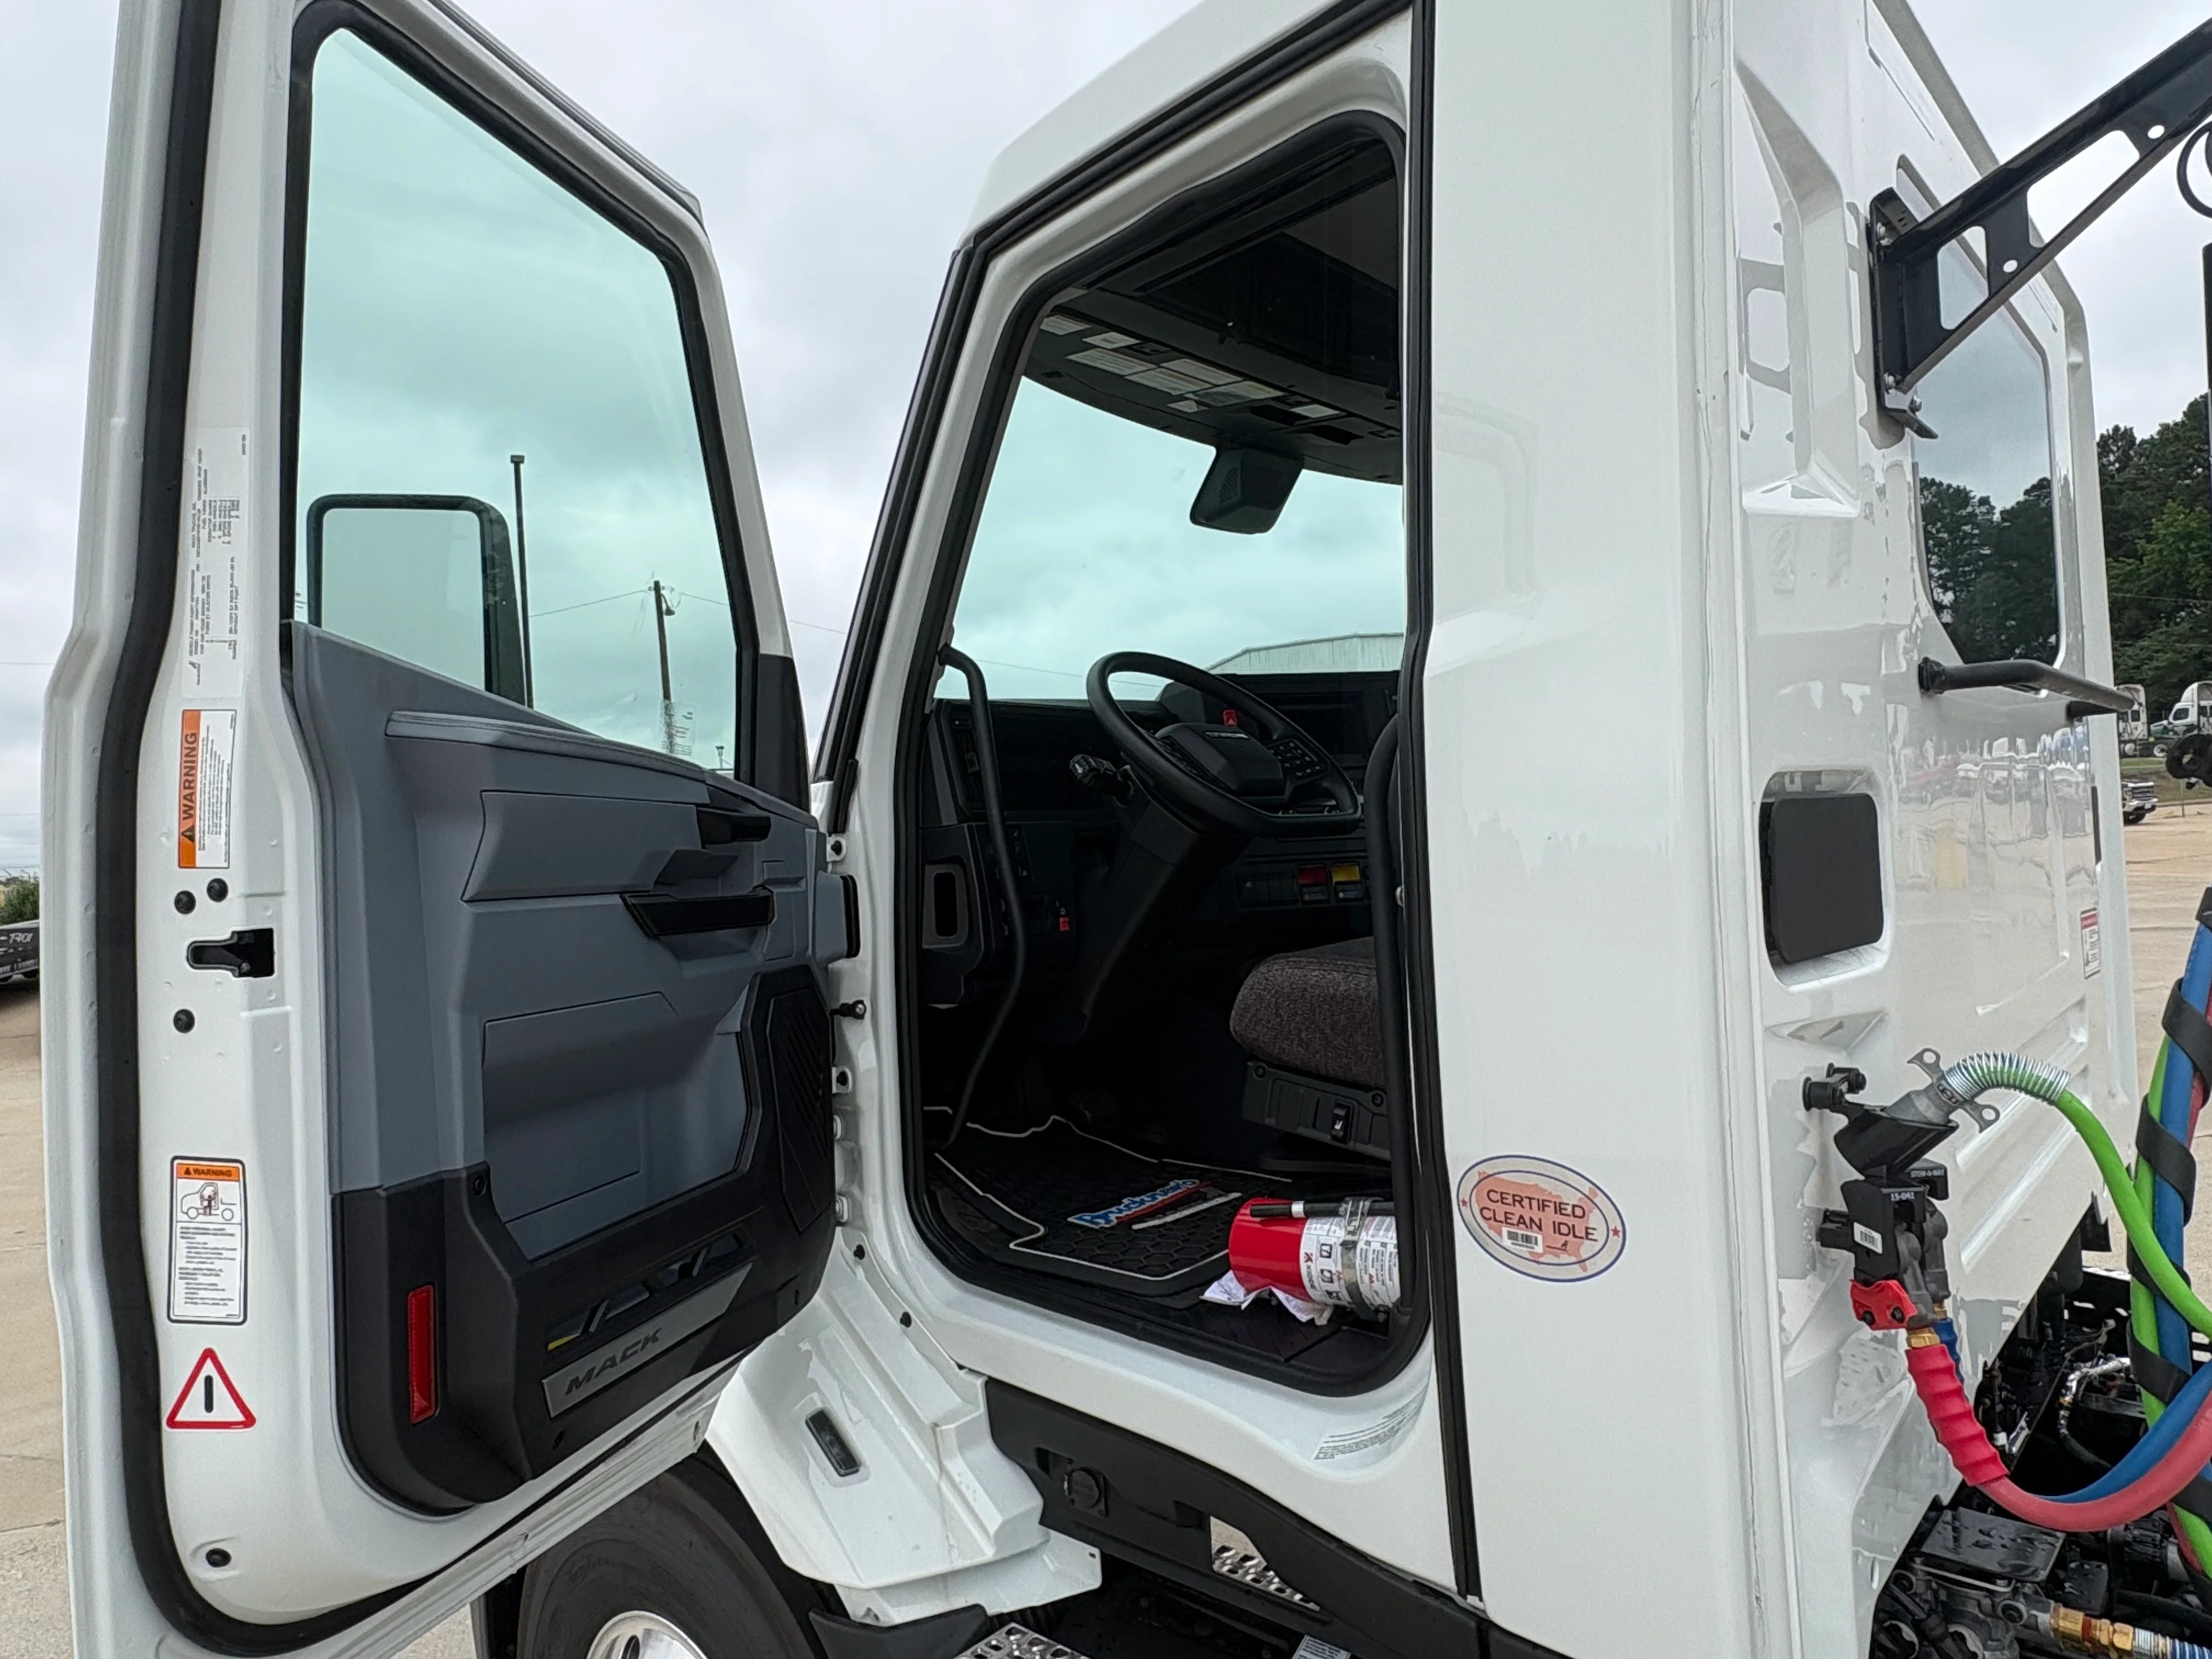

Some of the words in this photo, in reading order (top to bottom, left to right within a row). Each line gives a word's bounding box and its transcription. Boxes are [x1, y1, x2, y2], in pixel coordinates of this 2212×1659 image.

[182, 731, 198, 821] WARNING
[193, 1167, 233, 1177] WARNING
[1486, 1189, 1586, 1219] CERTIFIED
[1479, 1206, 1543, 1232] CLEAN
[1553, 1220, 1599, 1243] IDLE
[564, 1328, 663, 1396] MACK
